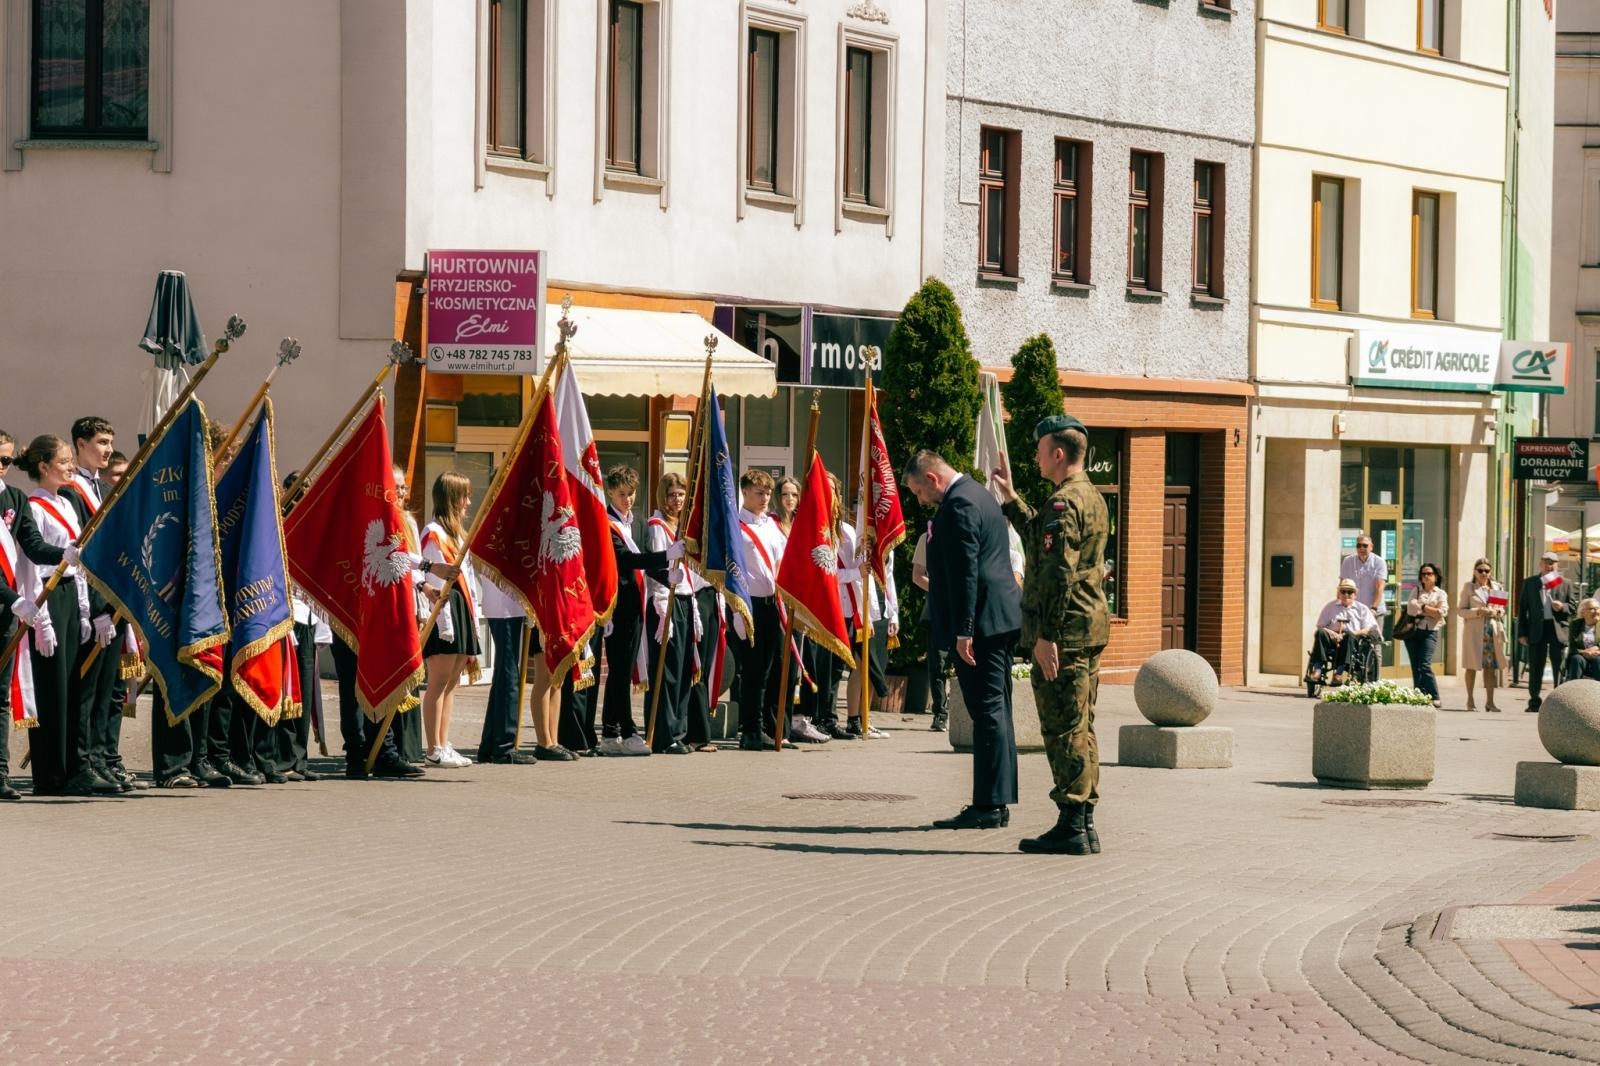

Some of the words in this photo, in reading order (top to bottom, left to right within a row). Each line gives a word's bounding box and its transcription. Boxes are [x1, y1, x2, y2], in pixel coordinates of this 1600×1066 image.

[431, 258, 537, 275] HURTOWNIA
[430, 279, 517, 293] FRYZJERSKO-
[429, 297, 537, 311] -KOSMETYCZNA
[455, 314, 510, 343] Elmi
[446, 349, 466, 361] +48
[469, 349, 488, 360] 782
[491, 350, 510, 361] 745
[513, 350, 532, 361] 783
[1391, 346, 1433, 369] CRÉDIT
[1435, 351, 1490, 373] AGRICOLE
[448, 361, 515, 371] www.elmihurt.pl
[1520, 445, 1567, 453] EXPRESOWE
[1520, 457, 1585, 468] DORABIANIE
[1533, 468, 1571, 477] KLUCZY
